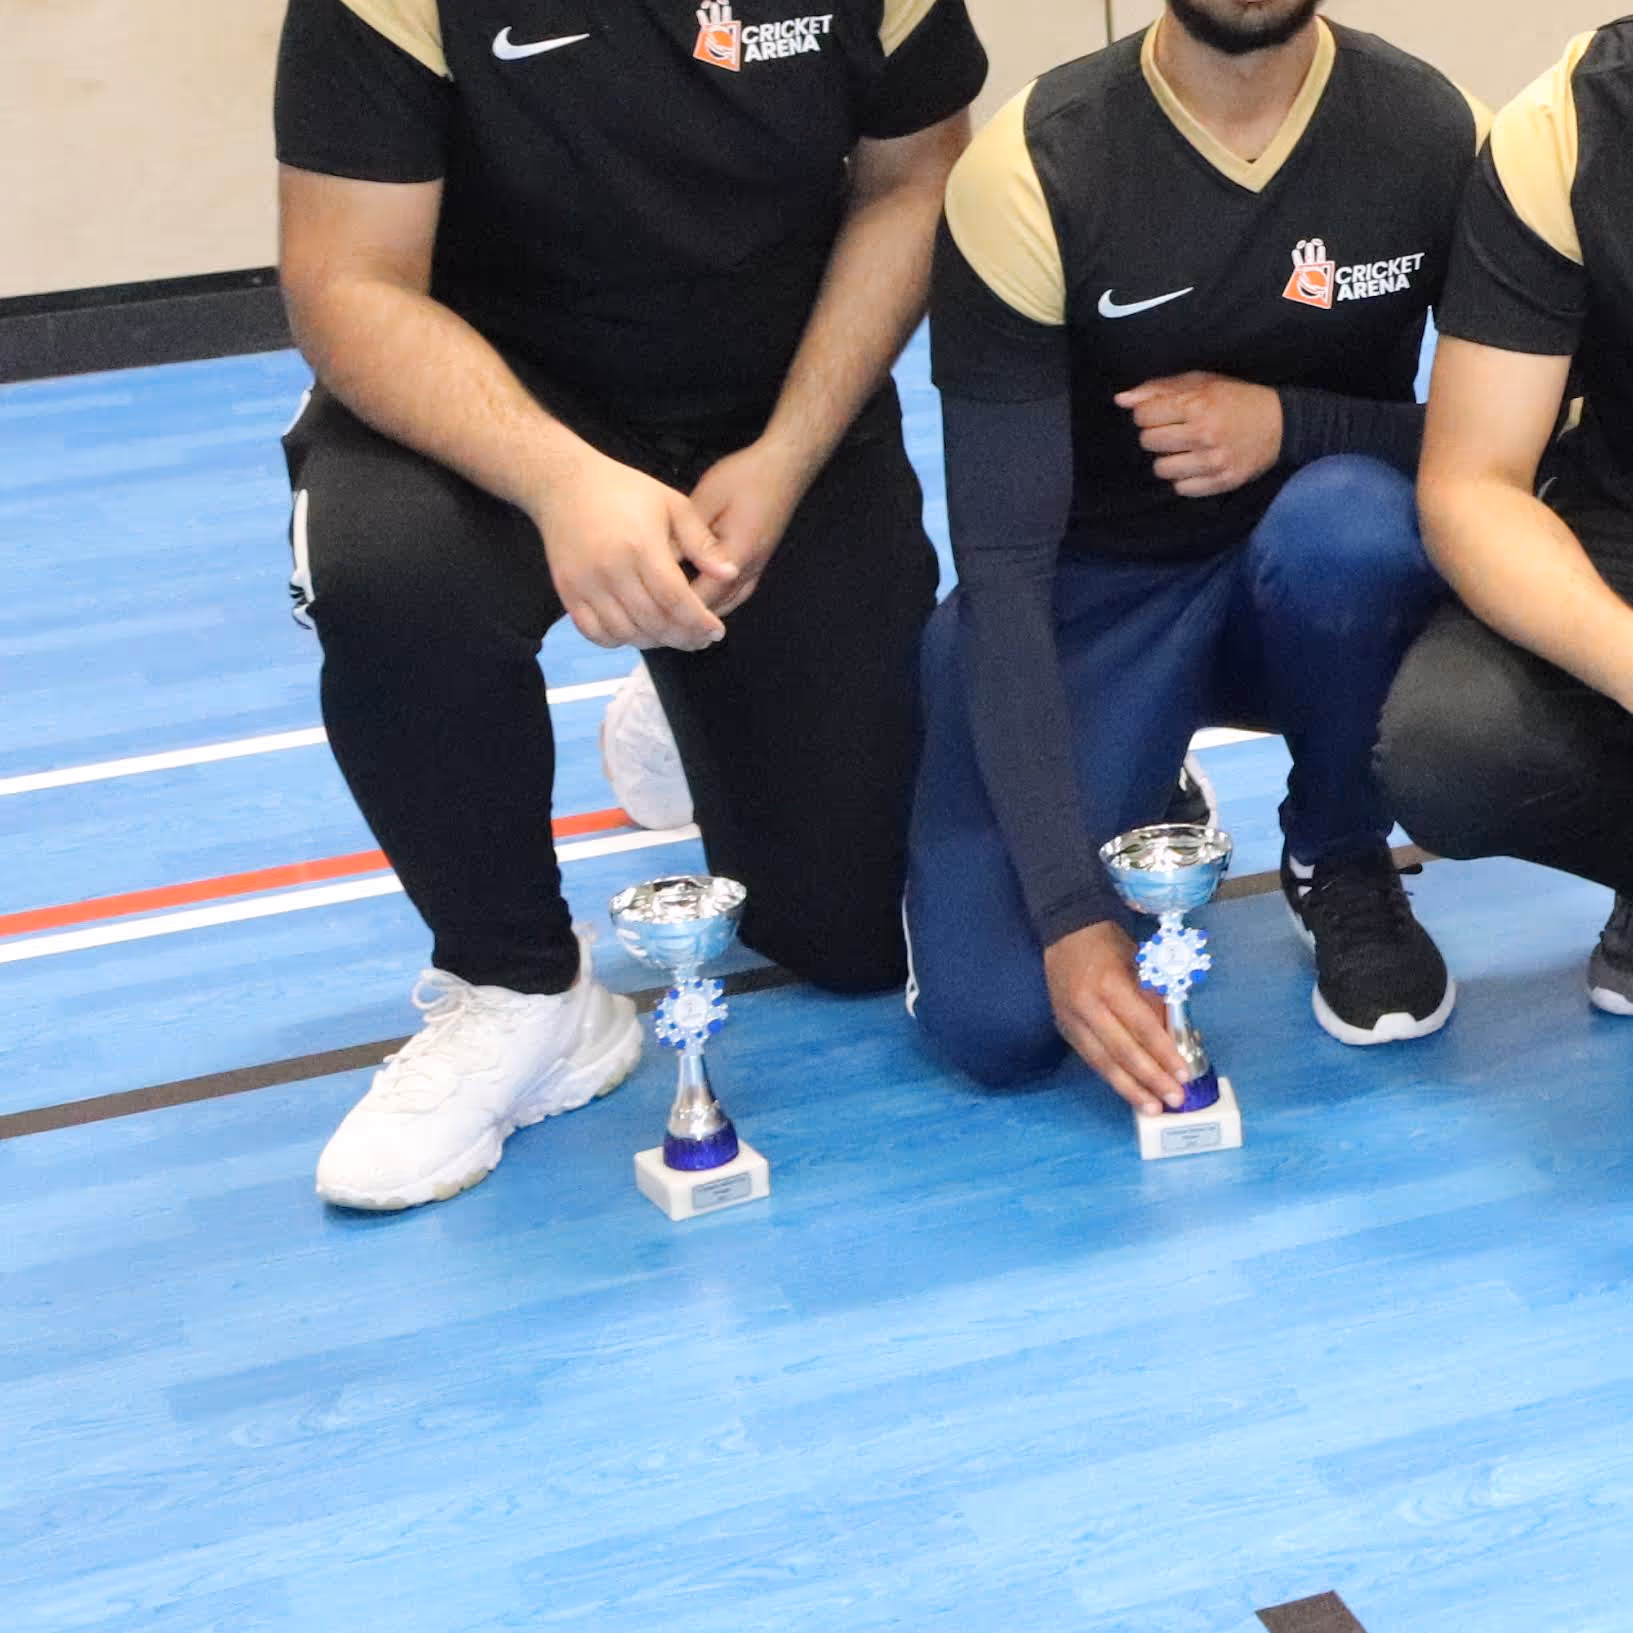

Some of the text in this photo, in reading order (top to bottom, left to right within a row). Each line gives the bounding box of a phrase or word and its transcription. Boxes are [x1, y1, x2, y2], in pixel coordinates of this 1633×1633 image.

[741, 14, 834, 45] CRICKET
[743, 34, 822, 63] ARENA
[1335, 252, 1426, 286] CRICKET
[1336, 273, 1411, 302] ARENA
